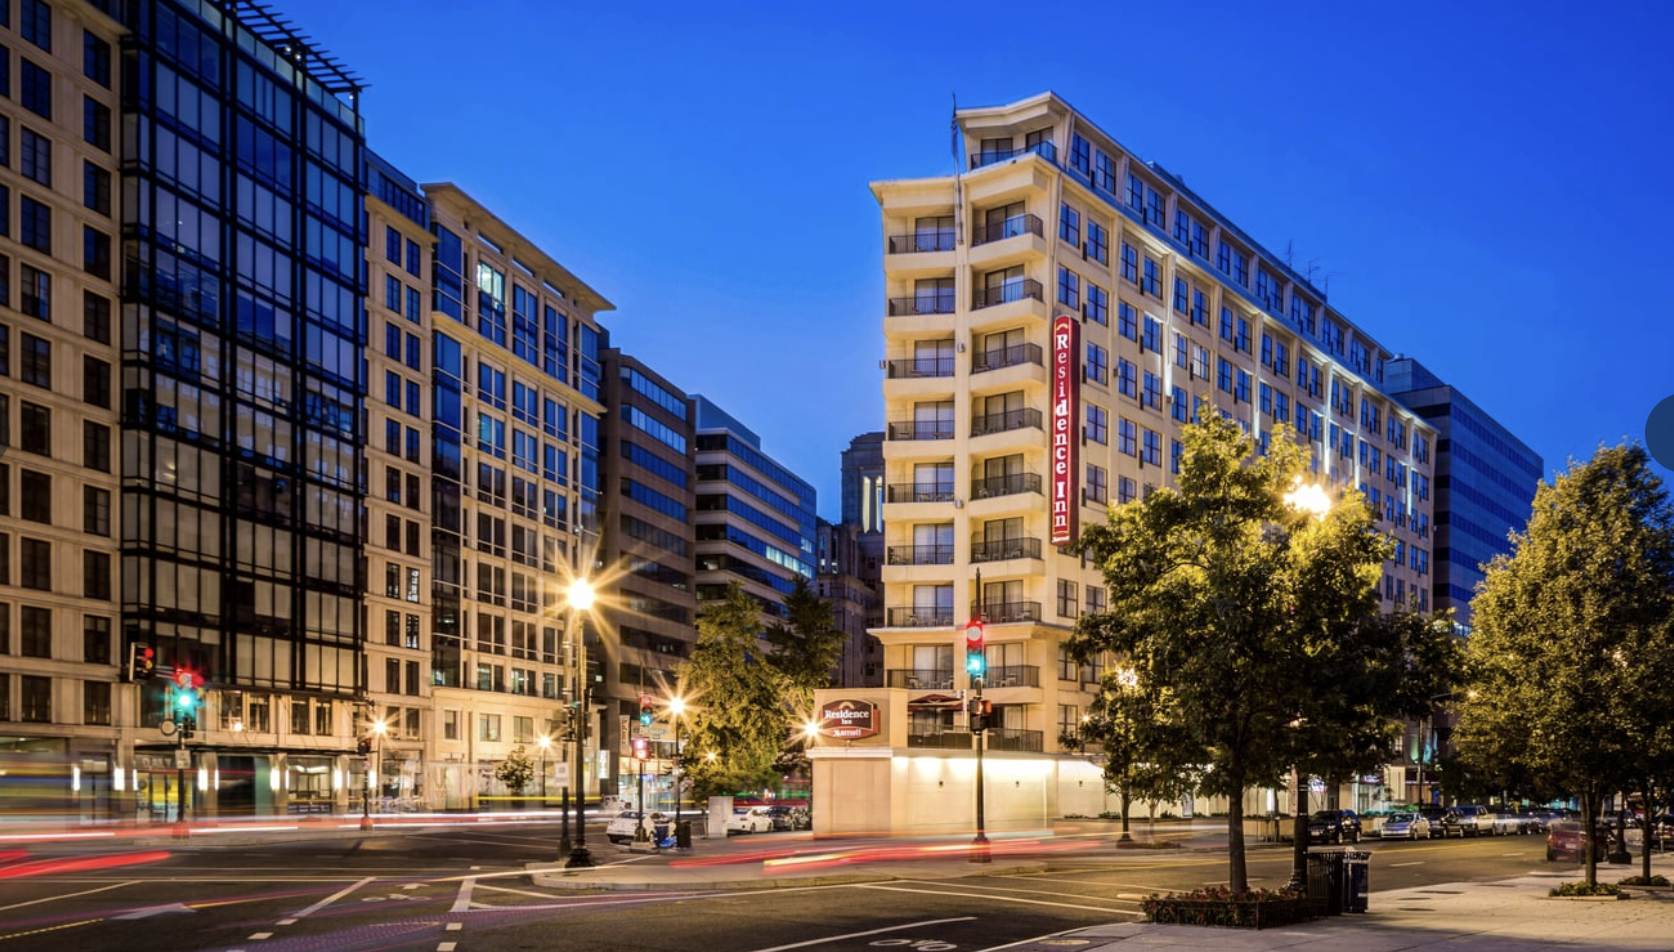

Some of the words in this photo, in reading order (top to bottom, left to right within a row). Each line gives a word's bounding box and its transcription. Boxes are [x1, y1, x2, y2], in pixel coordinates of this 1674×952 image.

[1056, 334, 1068, 474] Residence
[1055, 481, 1067, 527] Inn
[825, 709, 869, 719] Residence
